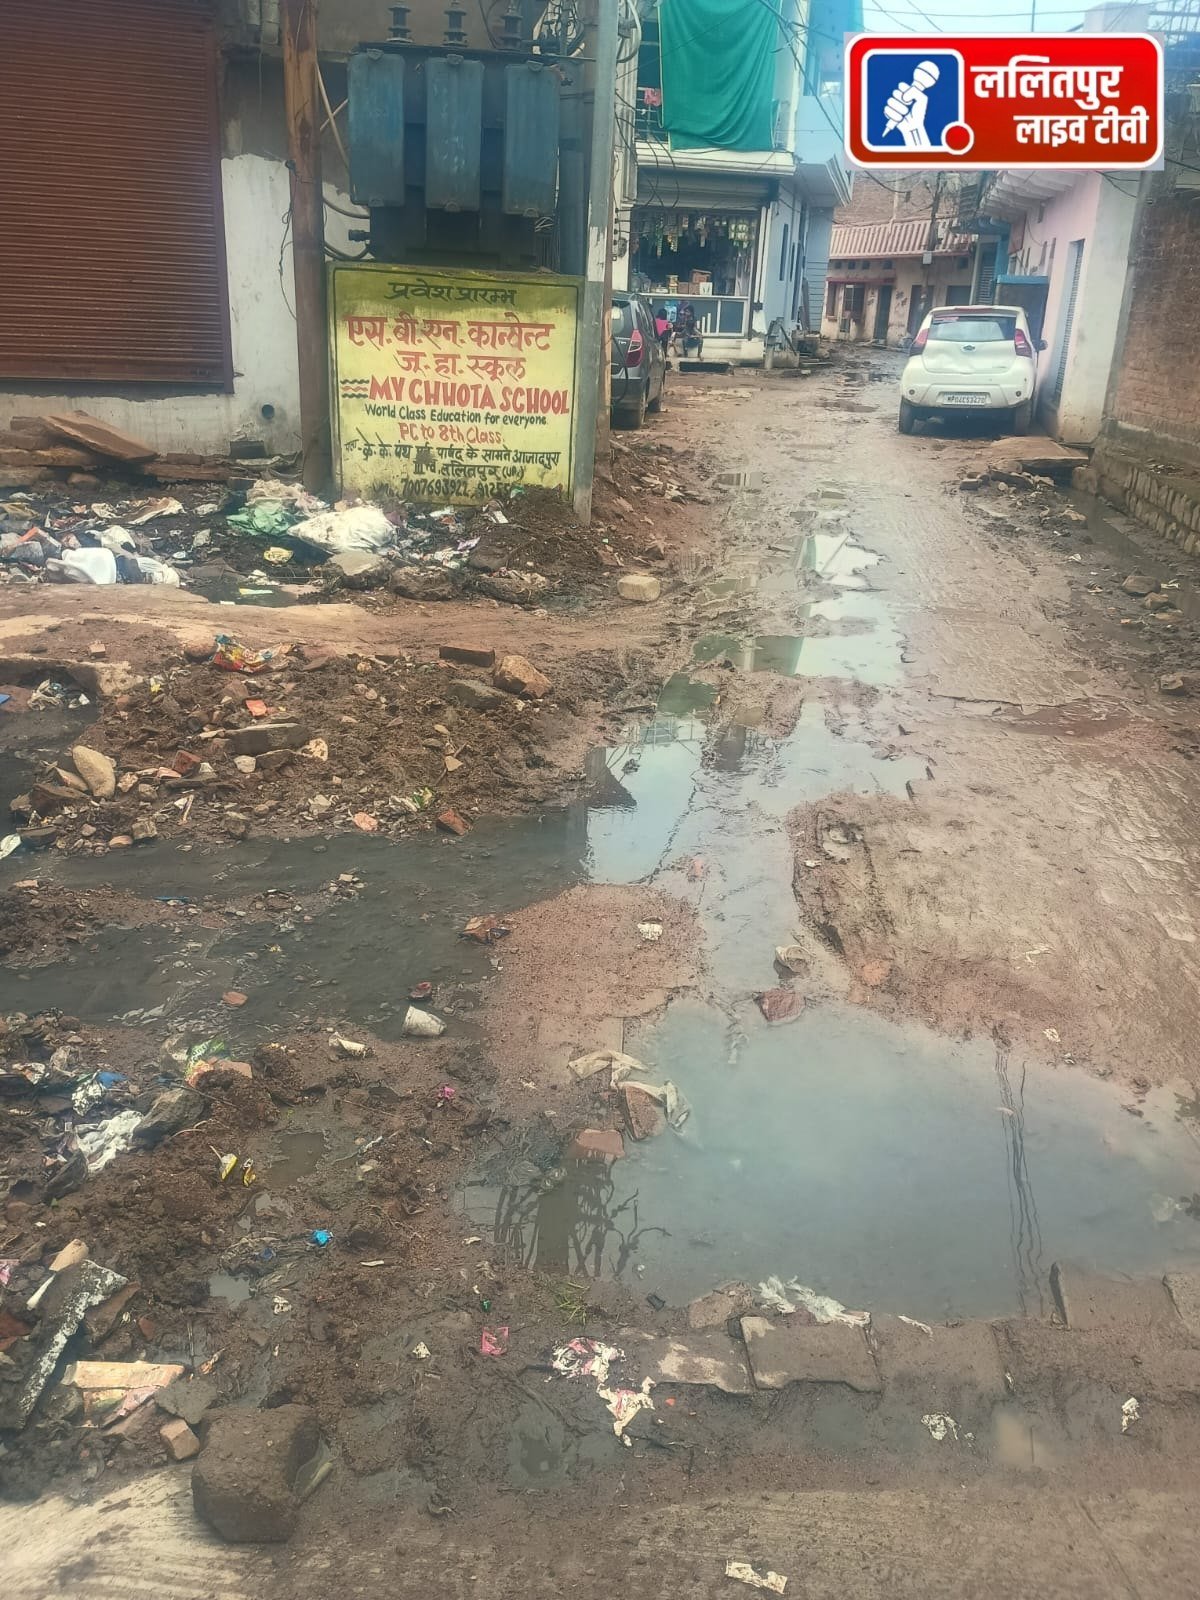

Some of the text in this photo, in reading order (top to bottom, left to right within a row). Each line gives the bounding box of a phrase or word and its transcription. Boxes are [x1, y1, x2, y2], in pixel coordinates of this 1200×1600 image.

[384, 278, 517, 305] प्रवेश प्रारम्भ
[466, 355, 526, 384] स्कूल
[368, 375, 570, 414] MY CHHOTA SCHOOL
[364, 403, 396, 418] World
[399, 406, 426, 421] Class
[430, 408, 481, 424] Education
[484, 411, 500, 425] for
[398, 422, 418, 441] PC
[420, 424, 435, 442] to
[439, 425, 464, 443] 8th
[466, 443, 480, 460] के
[481, 444, 512, 463] सामने
